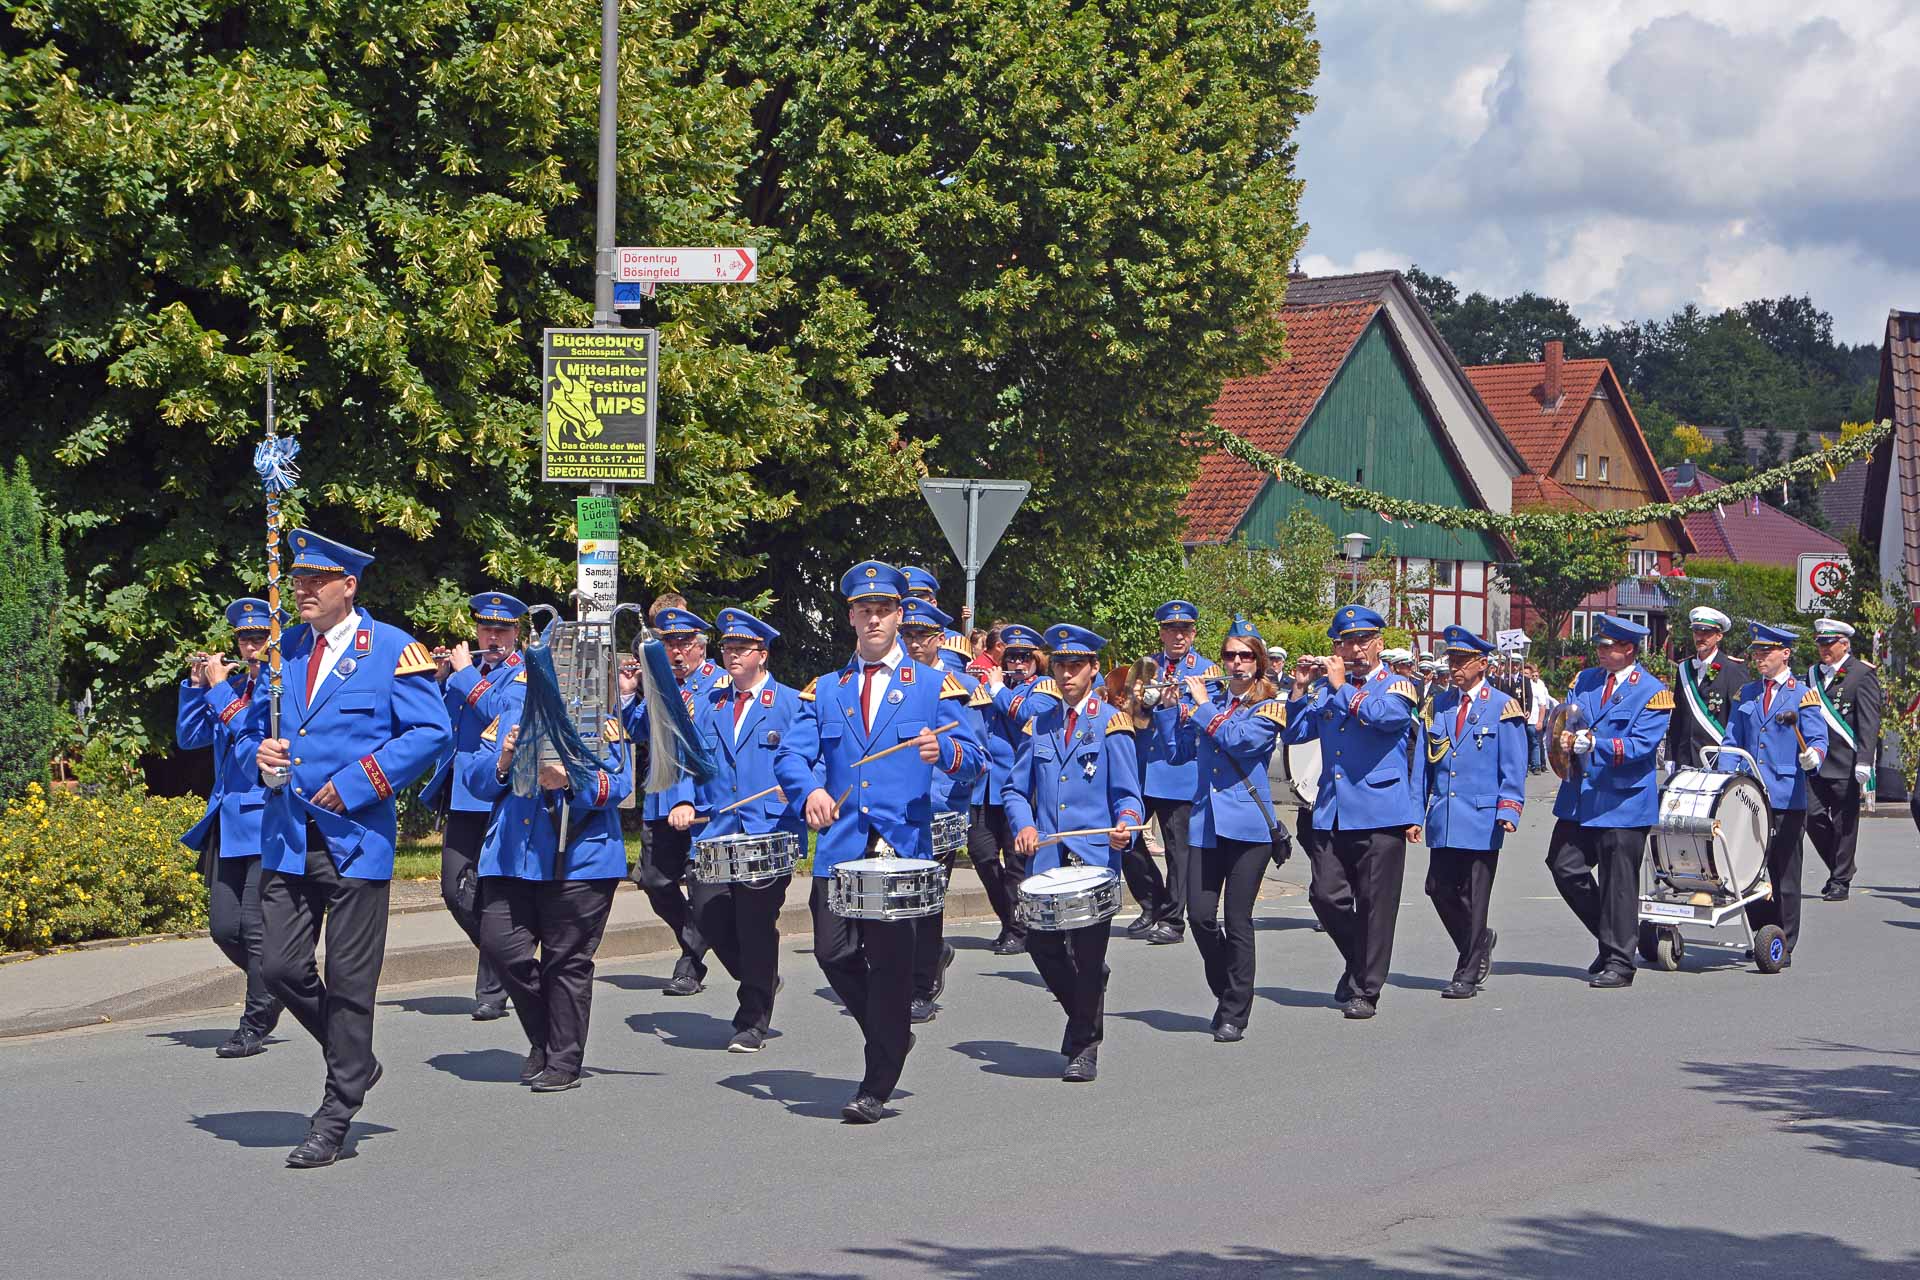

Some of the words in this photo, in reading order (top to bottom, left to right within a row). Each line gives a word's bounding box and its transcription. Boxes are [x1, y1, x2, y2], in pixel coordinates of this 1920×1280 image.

[623, 252, 678, 269] Dörentrup
[712, 252, 721, 264] 11
[623, 267, 680, 279] Bösingfeld
[552, 333, 645, 351] Bückeburg
[571, 348, 626, 358] Schlosspark
[567, 363, 647, 377] Mittelalter
[586, 380, 646, 393] Festival
[596, 397, 646, 415] MPS
[561, 442, 578, 450] Das
[579, 442, 609, 451] Größte
[610, 442, 624, 451] der
[626, 442, 645, 451] Welt
[547, 454, 578, 464] 9.+10.
[579, 455, 587, 463] &
[590, 454, 624, 464] 16.+17.
[627, 455, 645, 464] Juli
[547, 466, 646, 478] SPECTACULUM.DE
[1817, 571, 1839, 586] 30
[1740, 791, 1760, 816] SONOR
